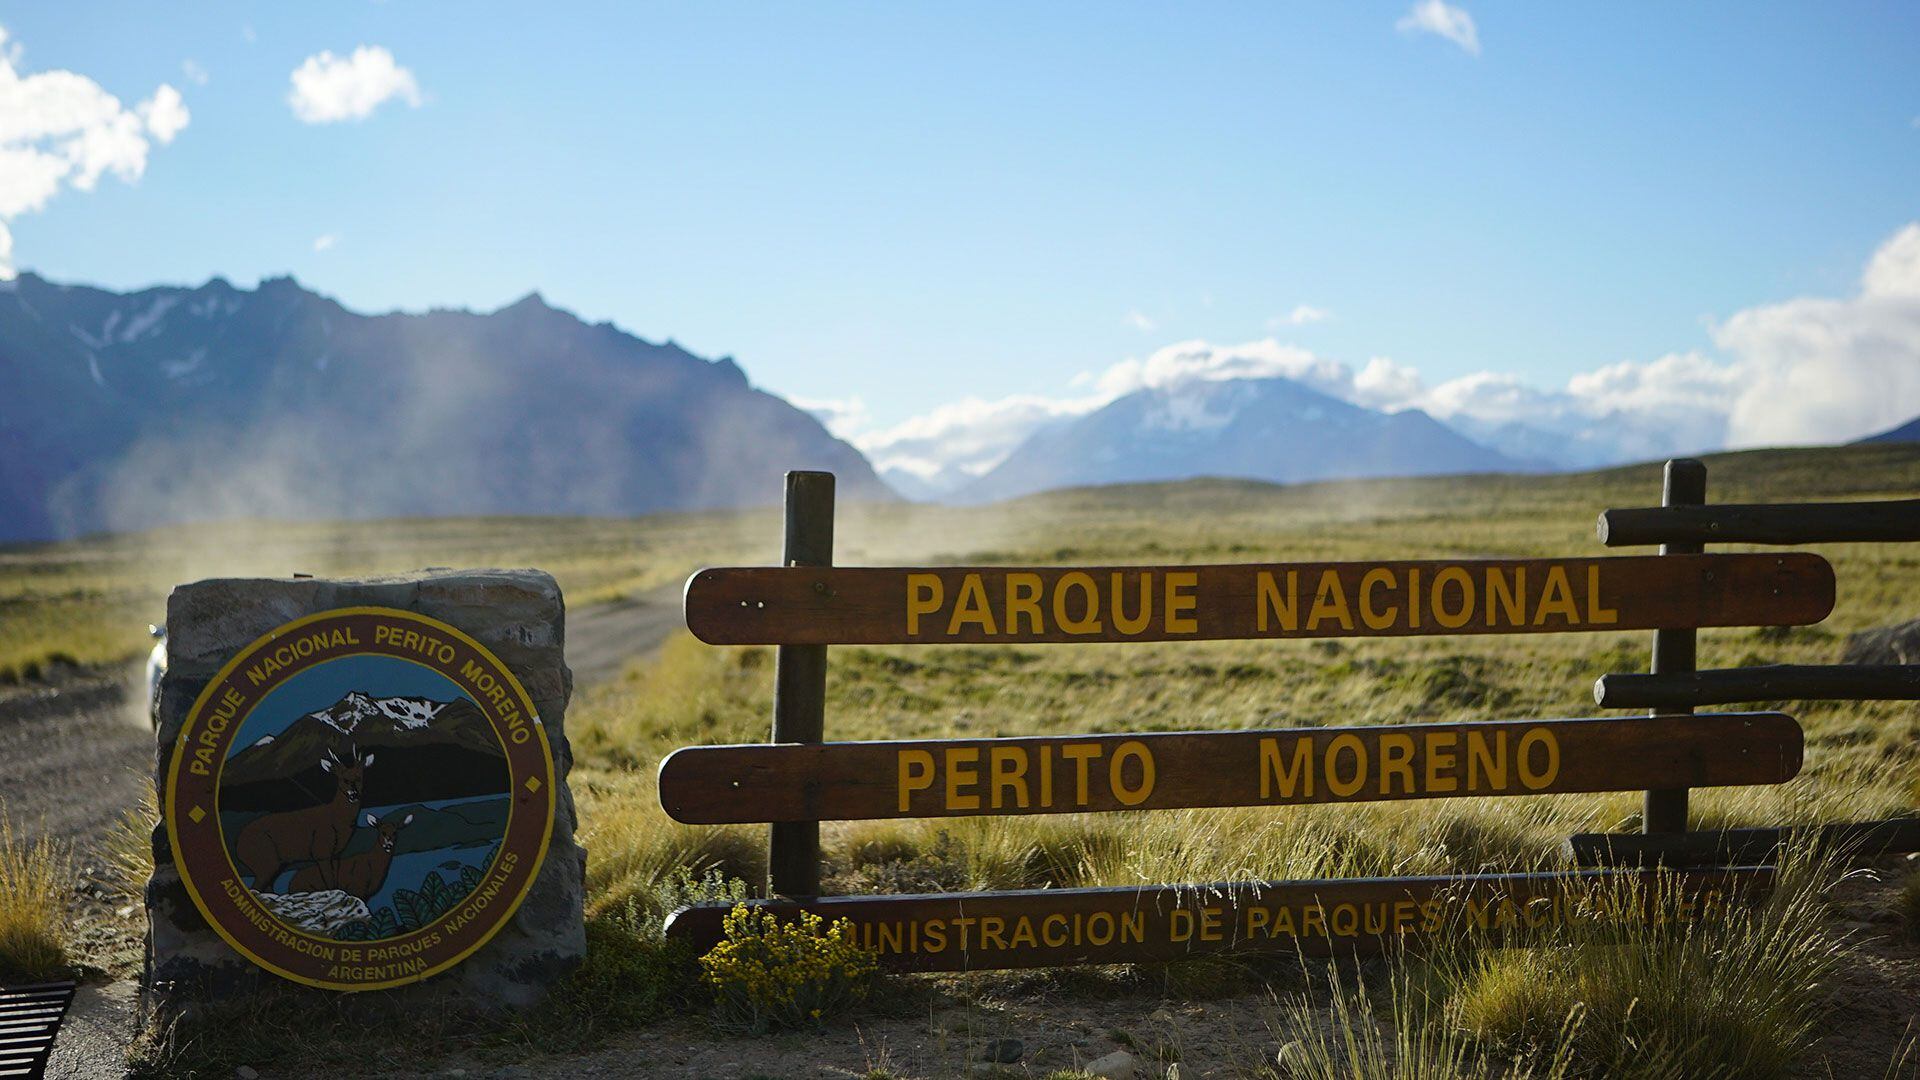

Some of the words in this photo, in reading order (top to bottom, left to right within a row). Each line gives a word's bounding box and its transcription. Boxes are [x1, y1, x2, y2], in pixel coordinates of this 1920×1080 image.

[907, 572, 1198, 635] PARQUE
[1256, 565, 1618, 632] NACIONAL
[190, 686, 246, 776] PARQUE
[246, 626, 360, 686] NACIONAL
[375, 625, 456, 664] PERITO
[460, 658, 530, 746] MORENO
[898, 741, 1155, 813] PERITO
[1260, 727, 1560, 799] MORENO
[221, 877, 335, 963] ADMINISTRACION
[340, 945, 363, 962] DE
[367, 932, 442, 962] PARQUES
[445, 851, 519, 933] NACIONALES
[1169, 908, 1223, 942] DE
[1246, 898, 1442, 939] PARQUES
[1466, 888, 1722, 930] NACIOLES
[328, 956, 428, 981] ARGENTINA
